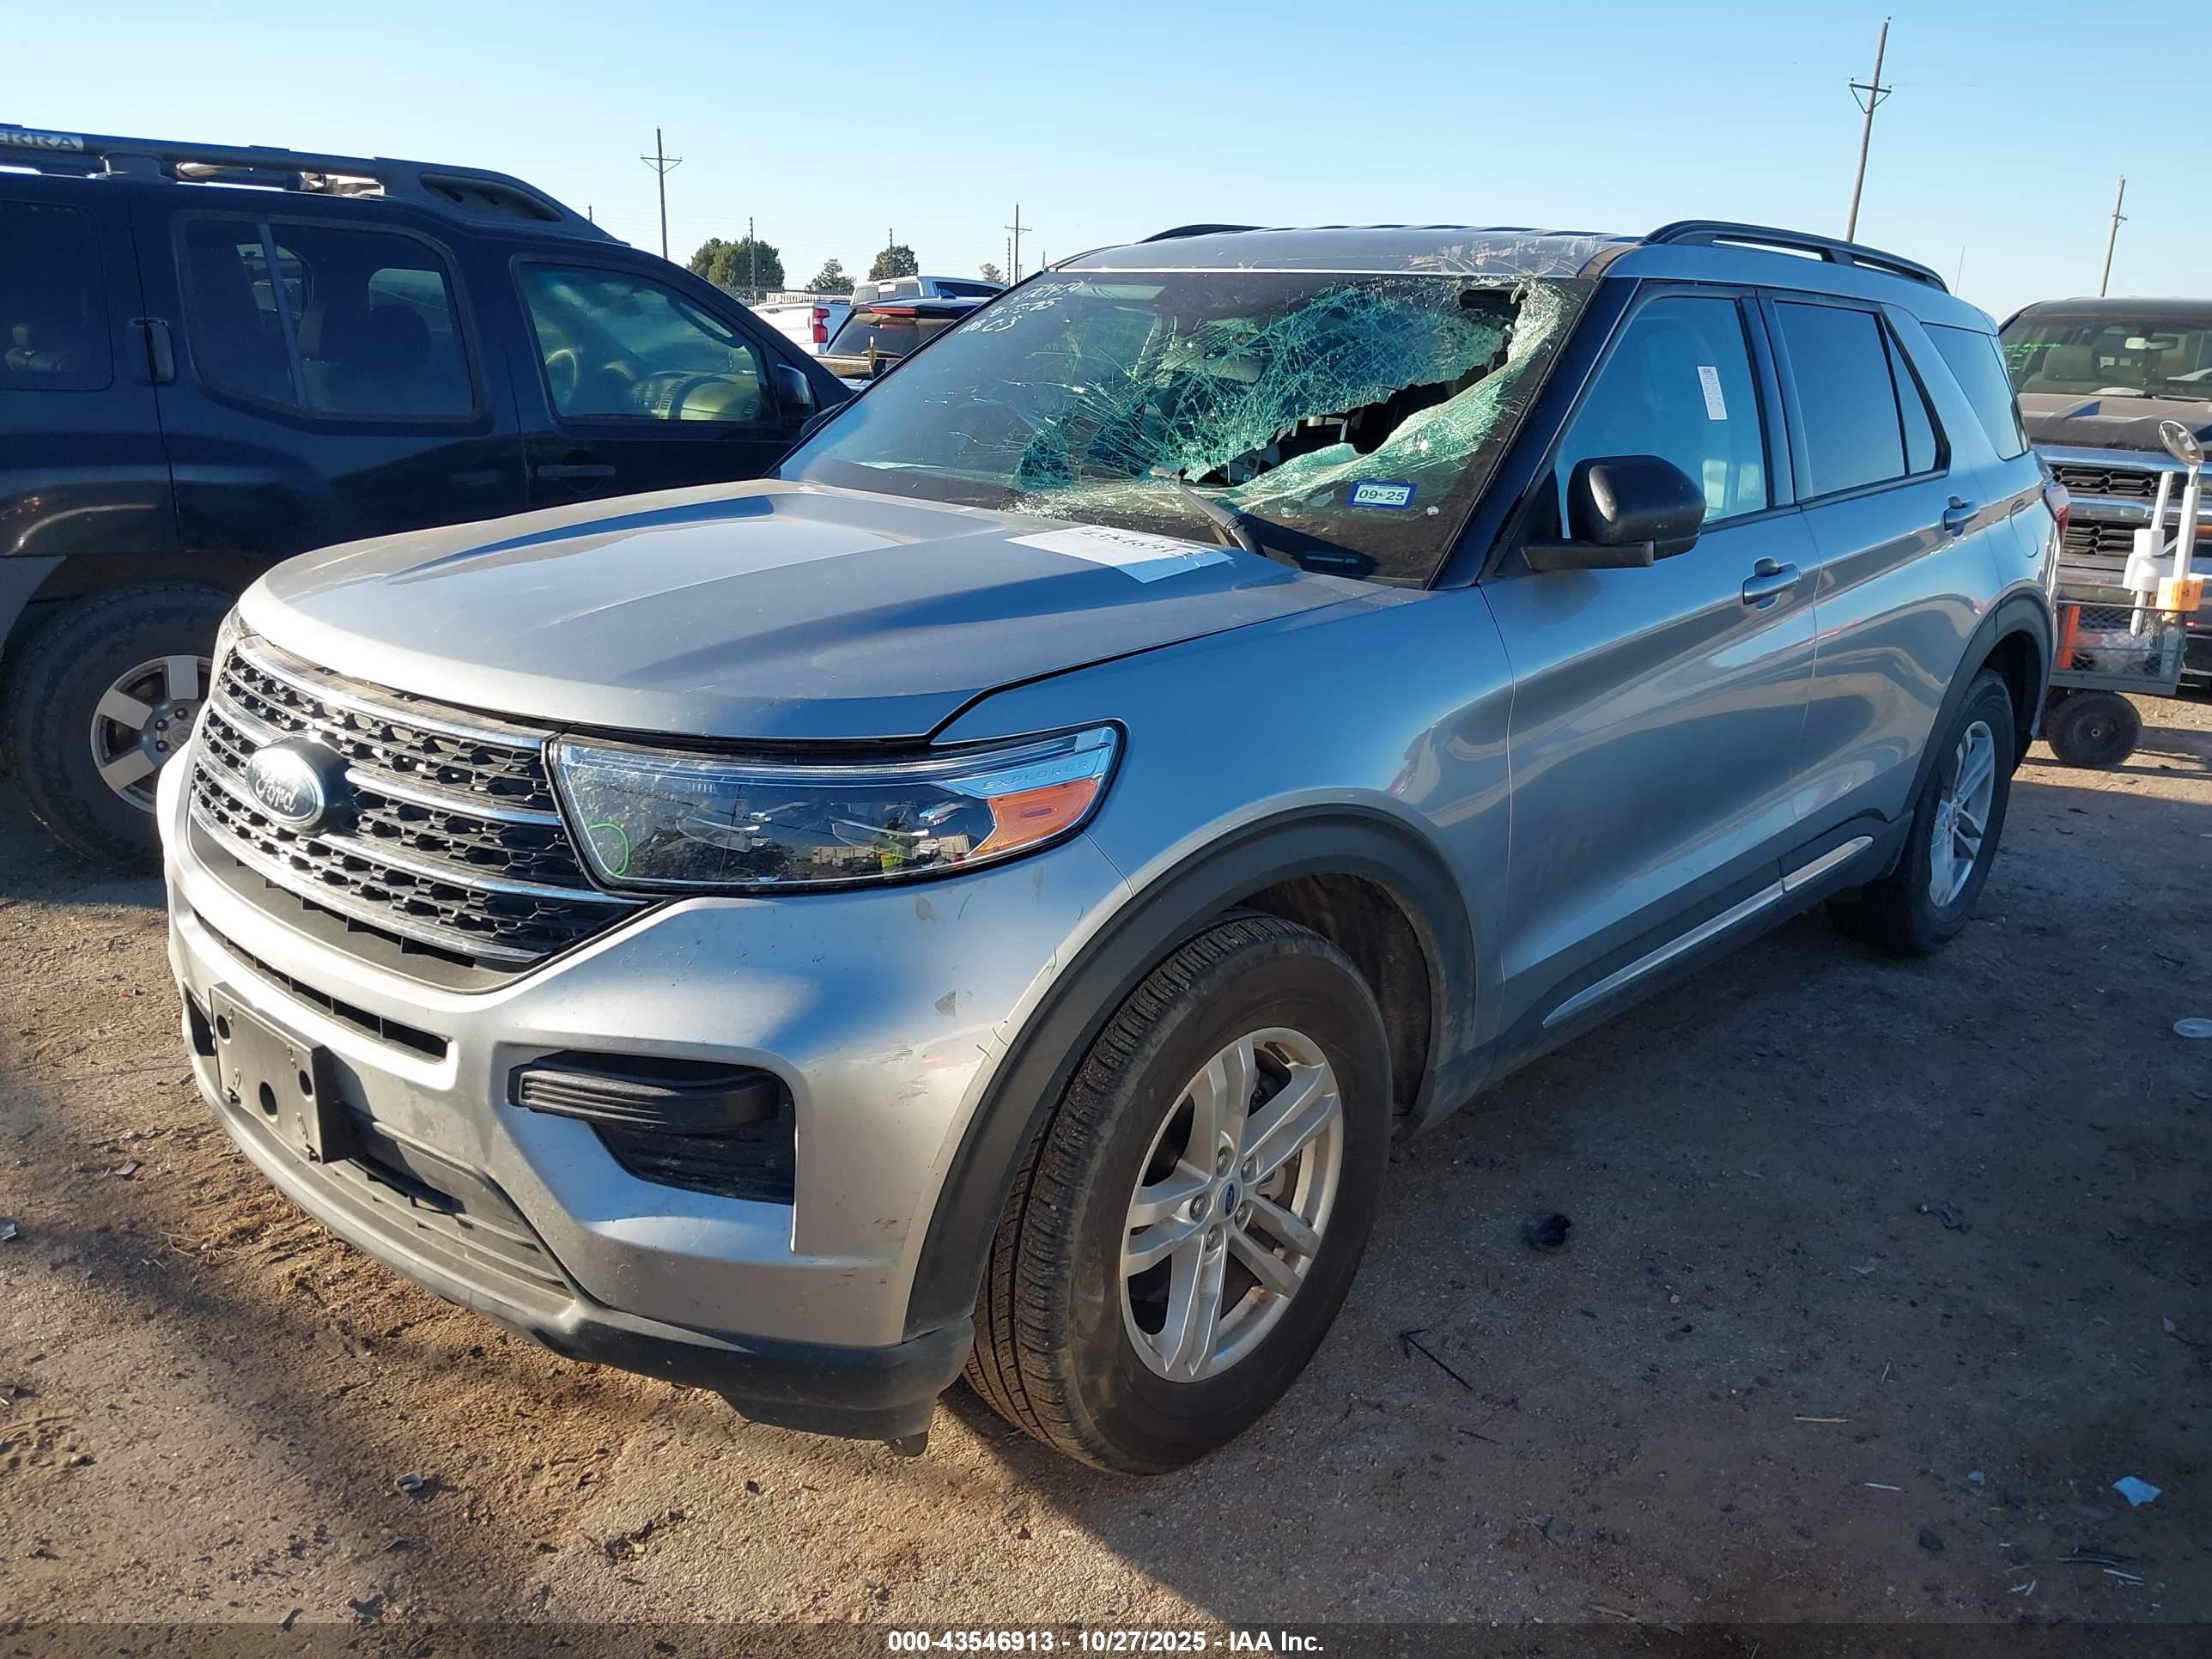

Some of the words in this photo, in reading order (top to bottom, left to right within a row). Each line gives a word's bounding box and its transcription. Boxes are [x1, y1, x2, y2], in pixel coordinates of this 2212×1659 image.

[1358, 489, 1378, 500] 09
[1385, 491, 1406, 501] 25
[982, 761, 1089, 790] EXPLORER
[255, 773, 299, 813] Ford
